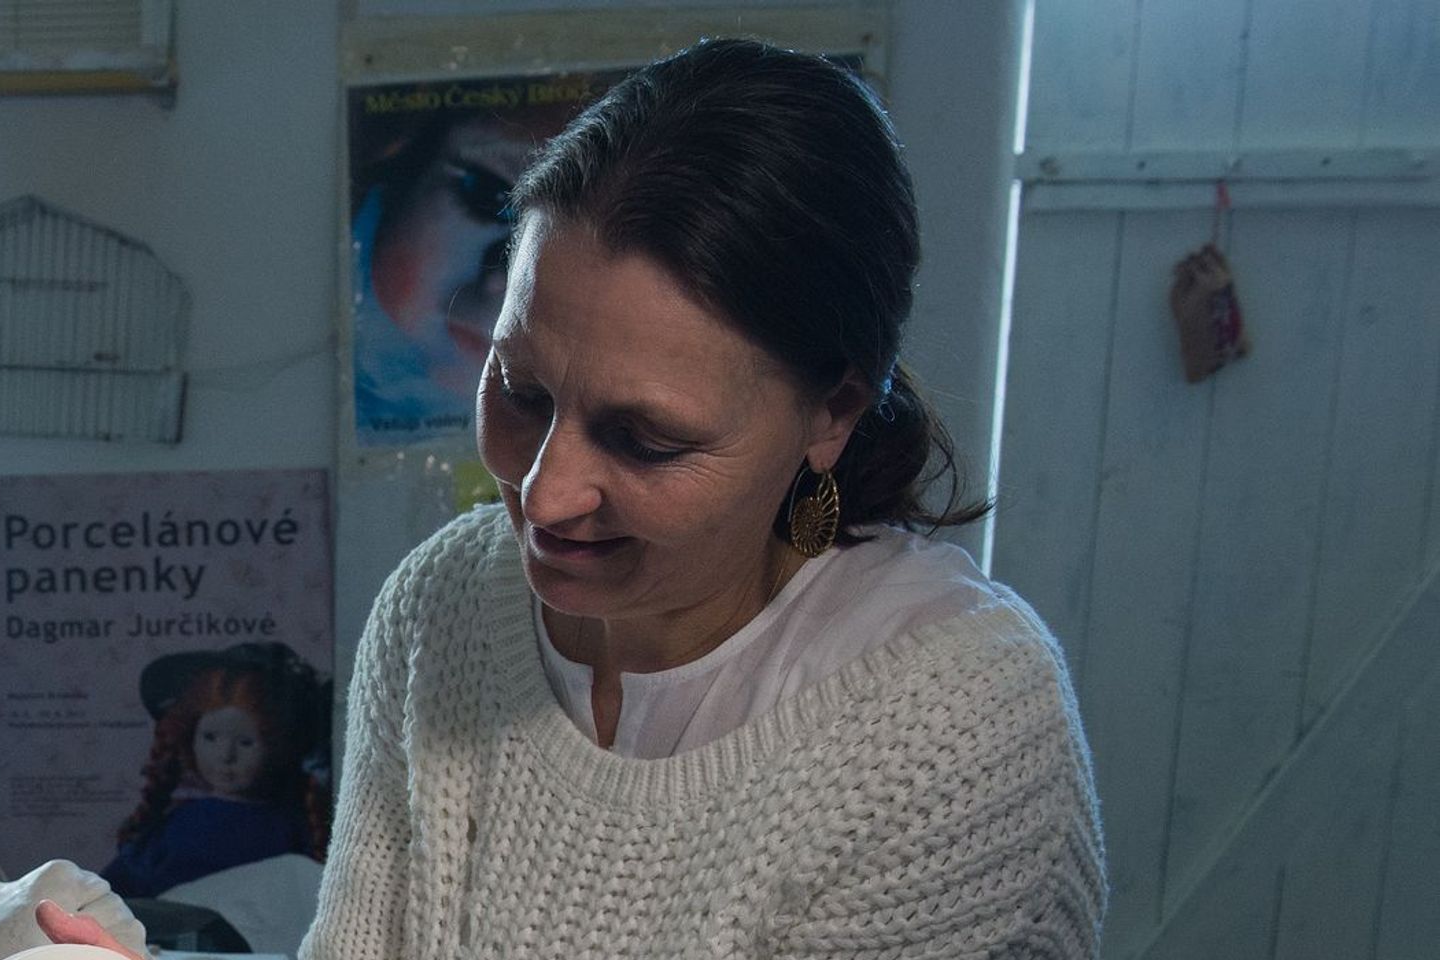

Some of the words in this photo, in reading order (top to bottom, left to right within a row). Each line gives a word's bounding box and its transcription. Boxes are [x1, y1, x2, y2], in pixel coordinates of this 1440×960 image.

[4, 508, 299, 551] Porcelánové
[5, 556, 205, 604] panenky
[6, 615, 114, 643] Dagmar
[127, 611, 277, 638] Jurčíkové
